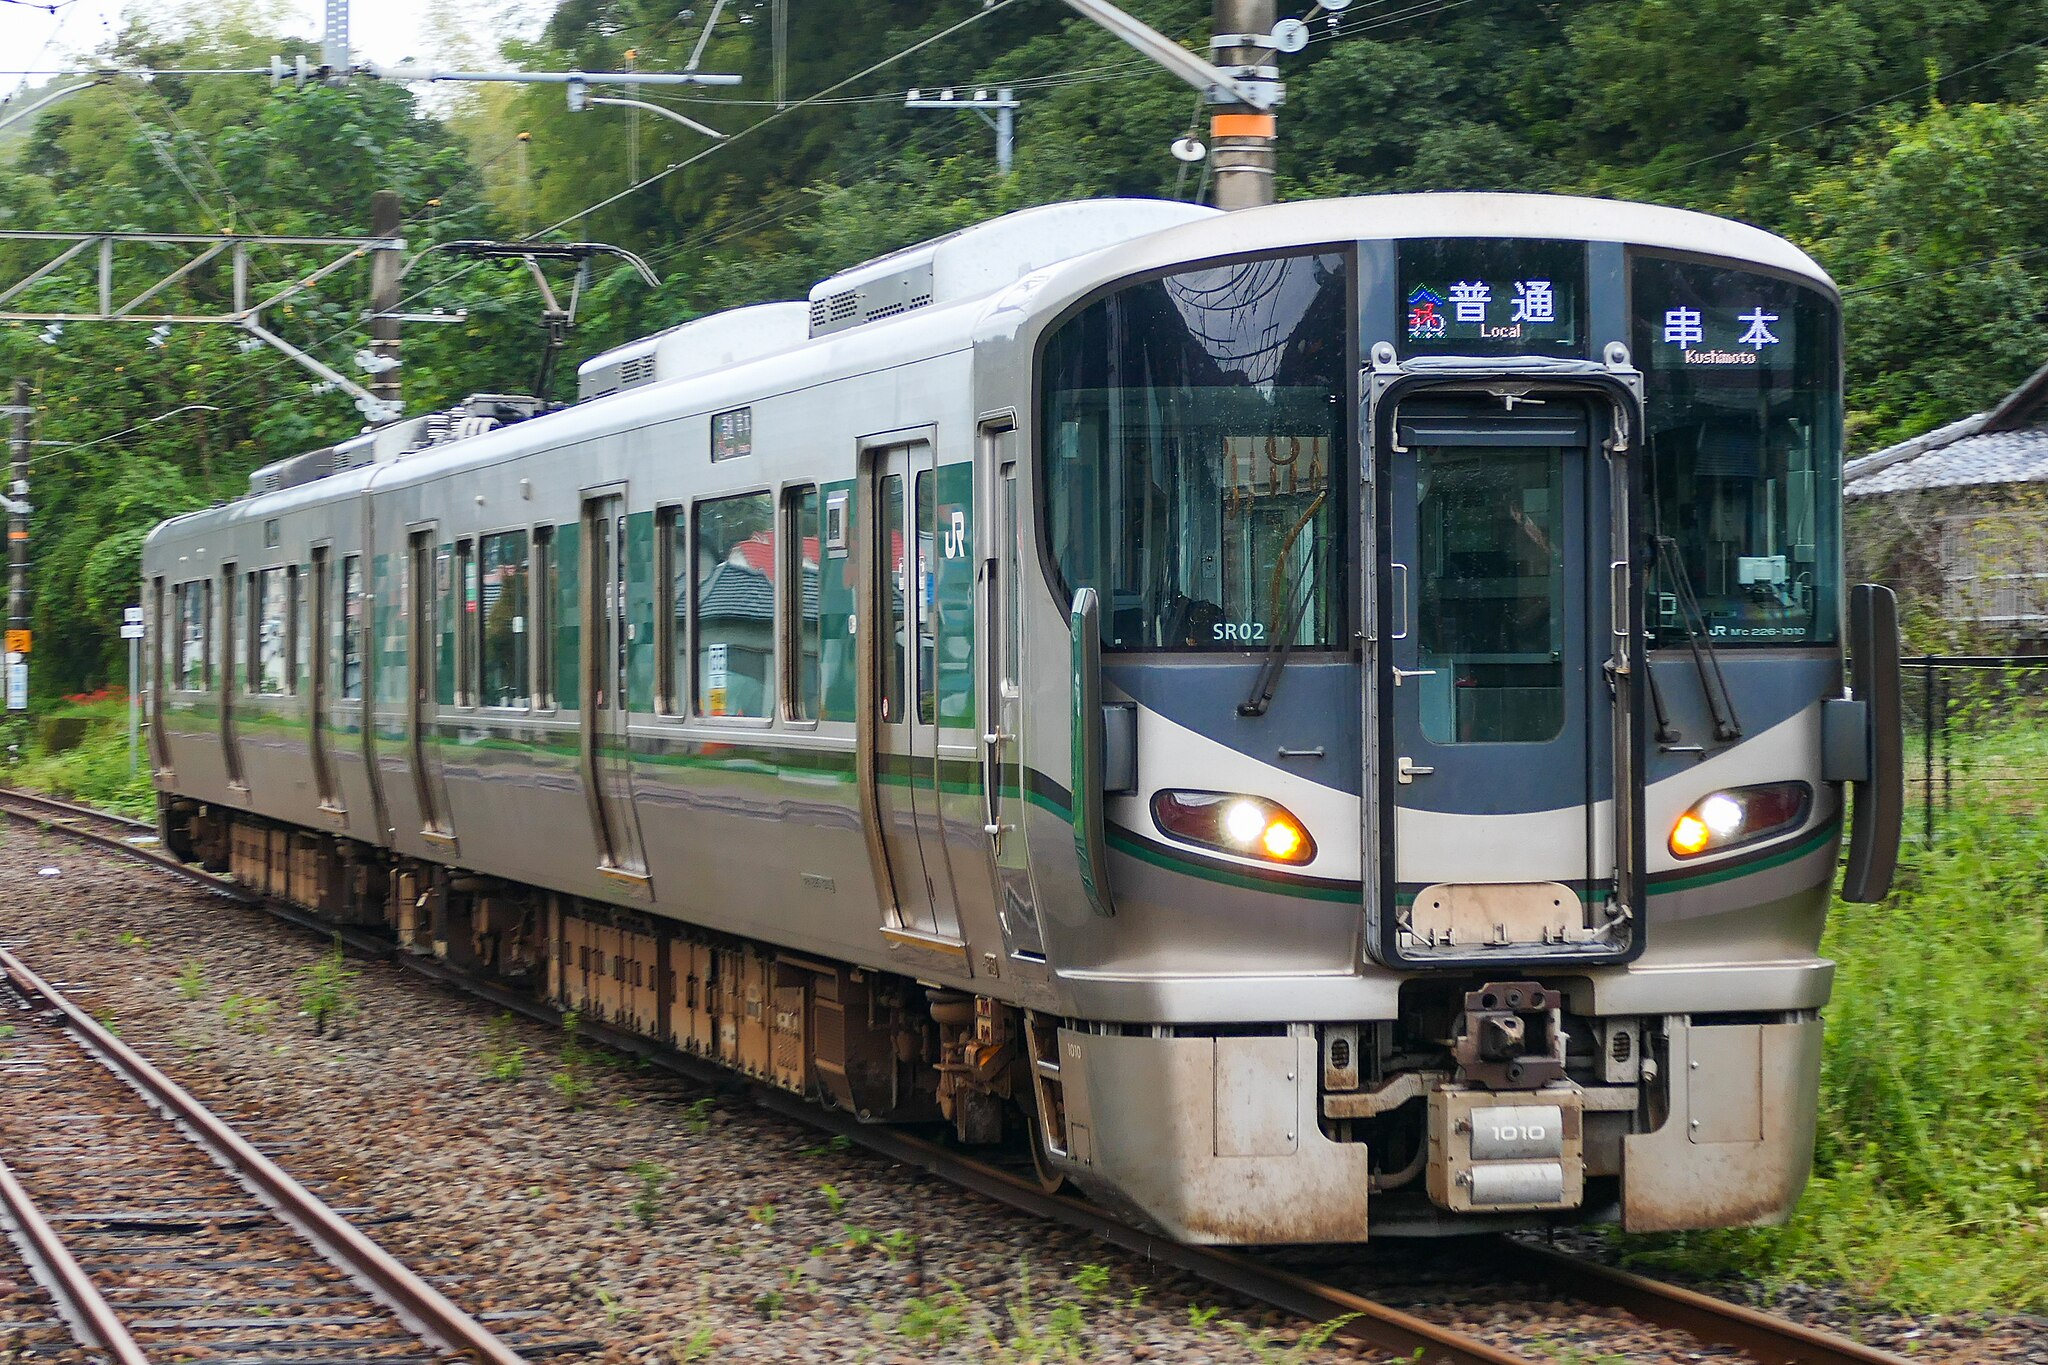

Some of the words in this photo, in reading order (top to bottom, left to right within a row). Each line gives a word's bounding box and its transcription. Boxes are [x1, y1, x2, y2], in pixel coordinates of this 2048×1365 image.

[1449, 280, 1555, 322] 普通
[1481, 323, 1522, 339] Local
[1664, 305, 1780, 350] 串本
[1685, 349, 1757, 364] Kushimoto
[944, 511, 966, 560] JR
[1213, 623, 1265, 640] SR02
[1708, 625, 1727, 637] JR
[1750, 627, 1807, 637] 226-1010
[1067, 1043, 1082, 1060] 1010
[1491, 1125, 1546, 1142] 1010
